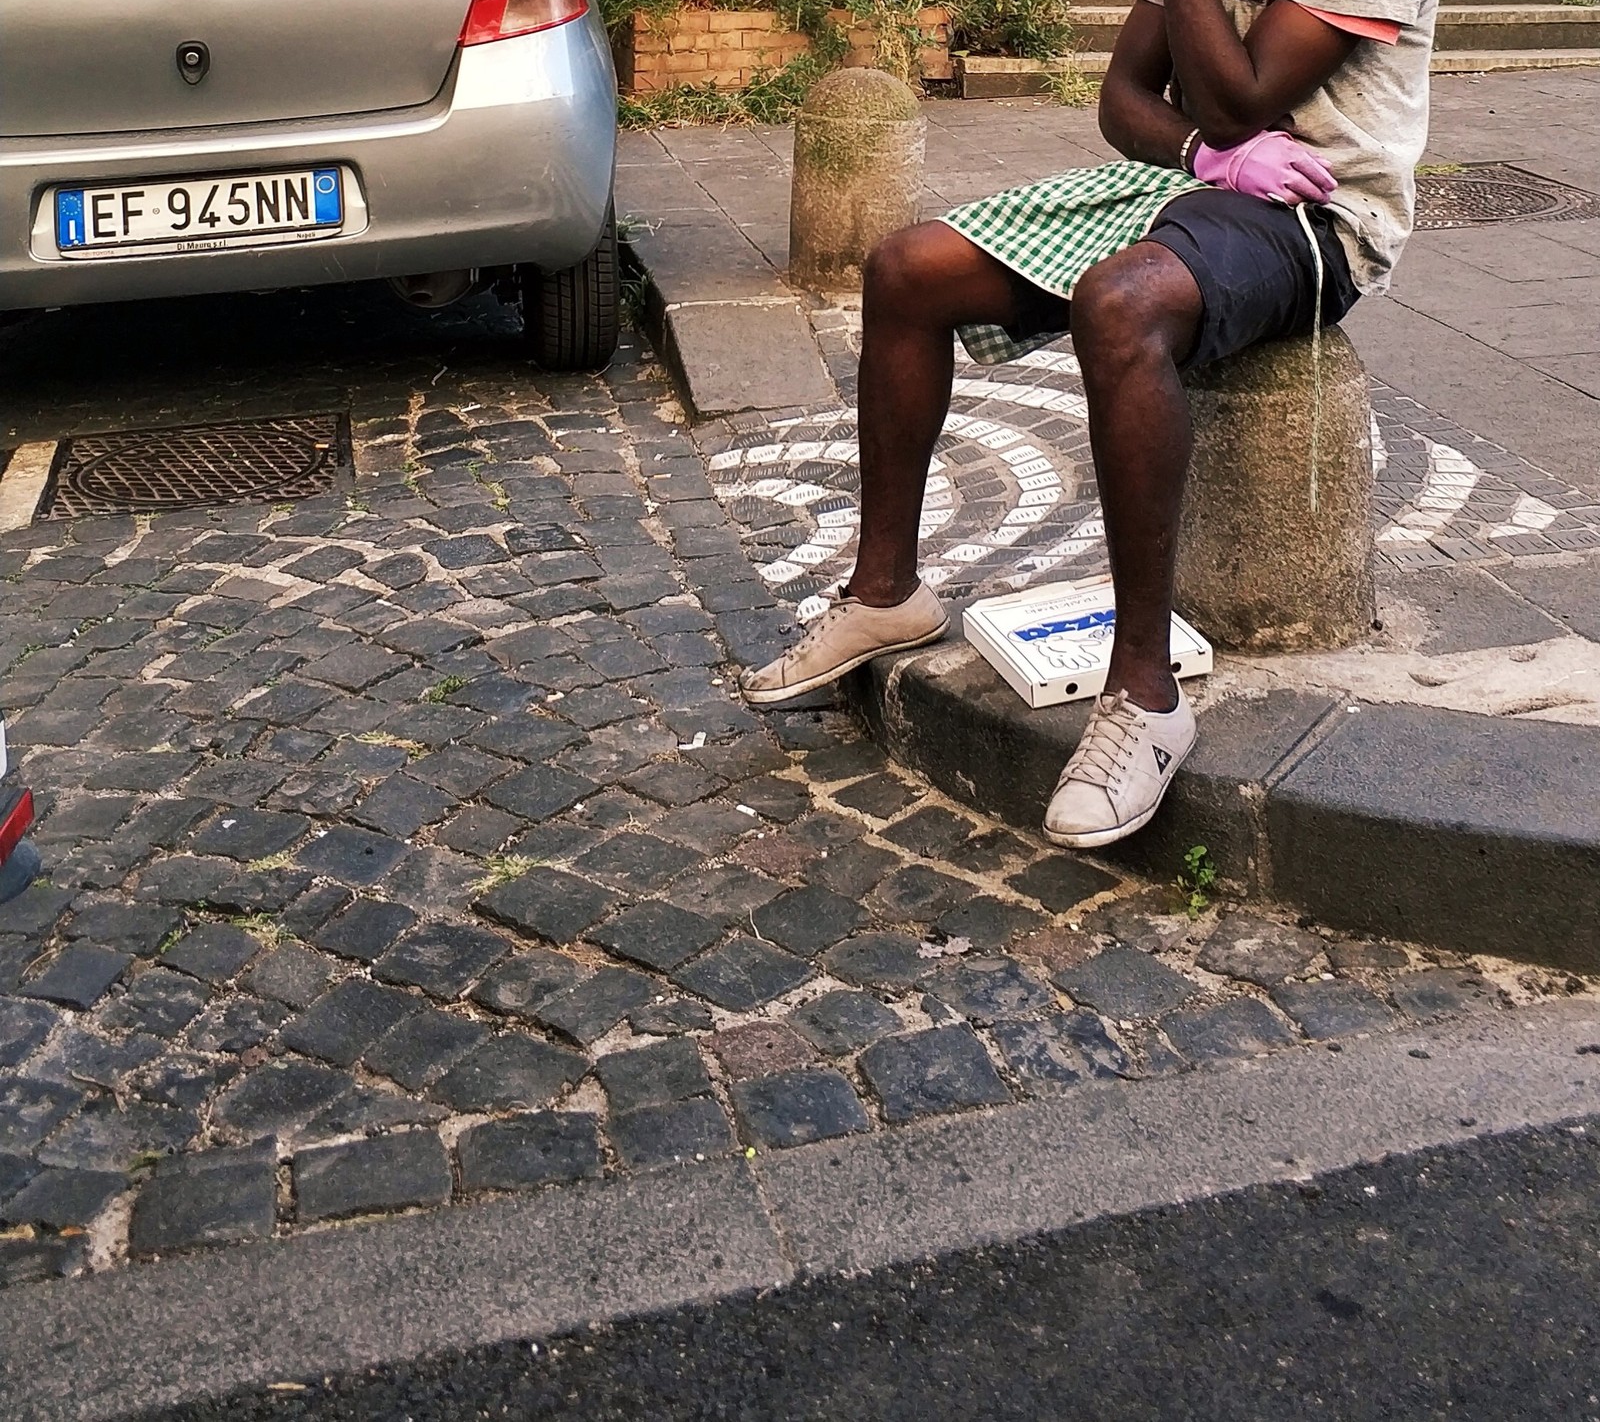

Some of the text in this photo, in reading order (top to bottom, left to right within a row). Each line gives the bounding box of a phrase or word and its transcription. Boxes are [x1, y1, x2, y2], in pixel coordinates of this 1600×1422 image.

[92, 177, 310, 239] EF 945NN
[1014, 609, 1116, 642] izza
